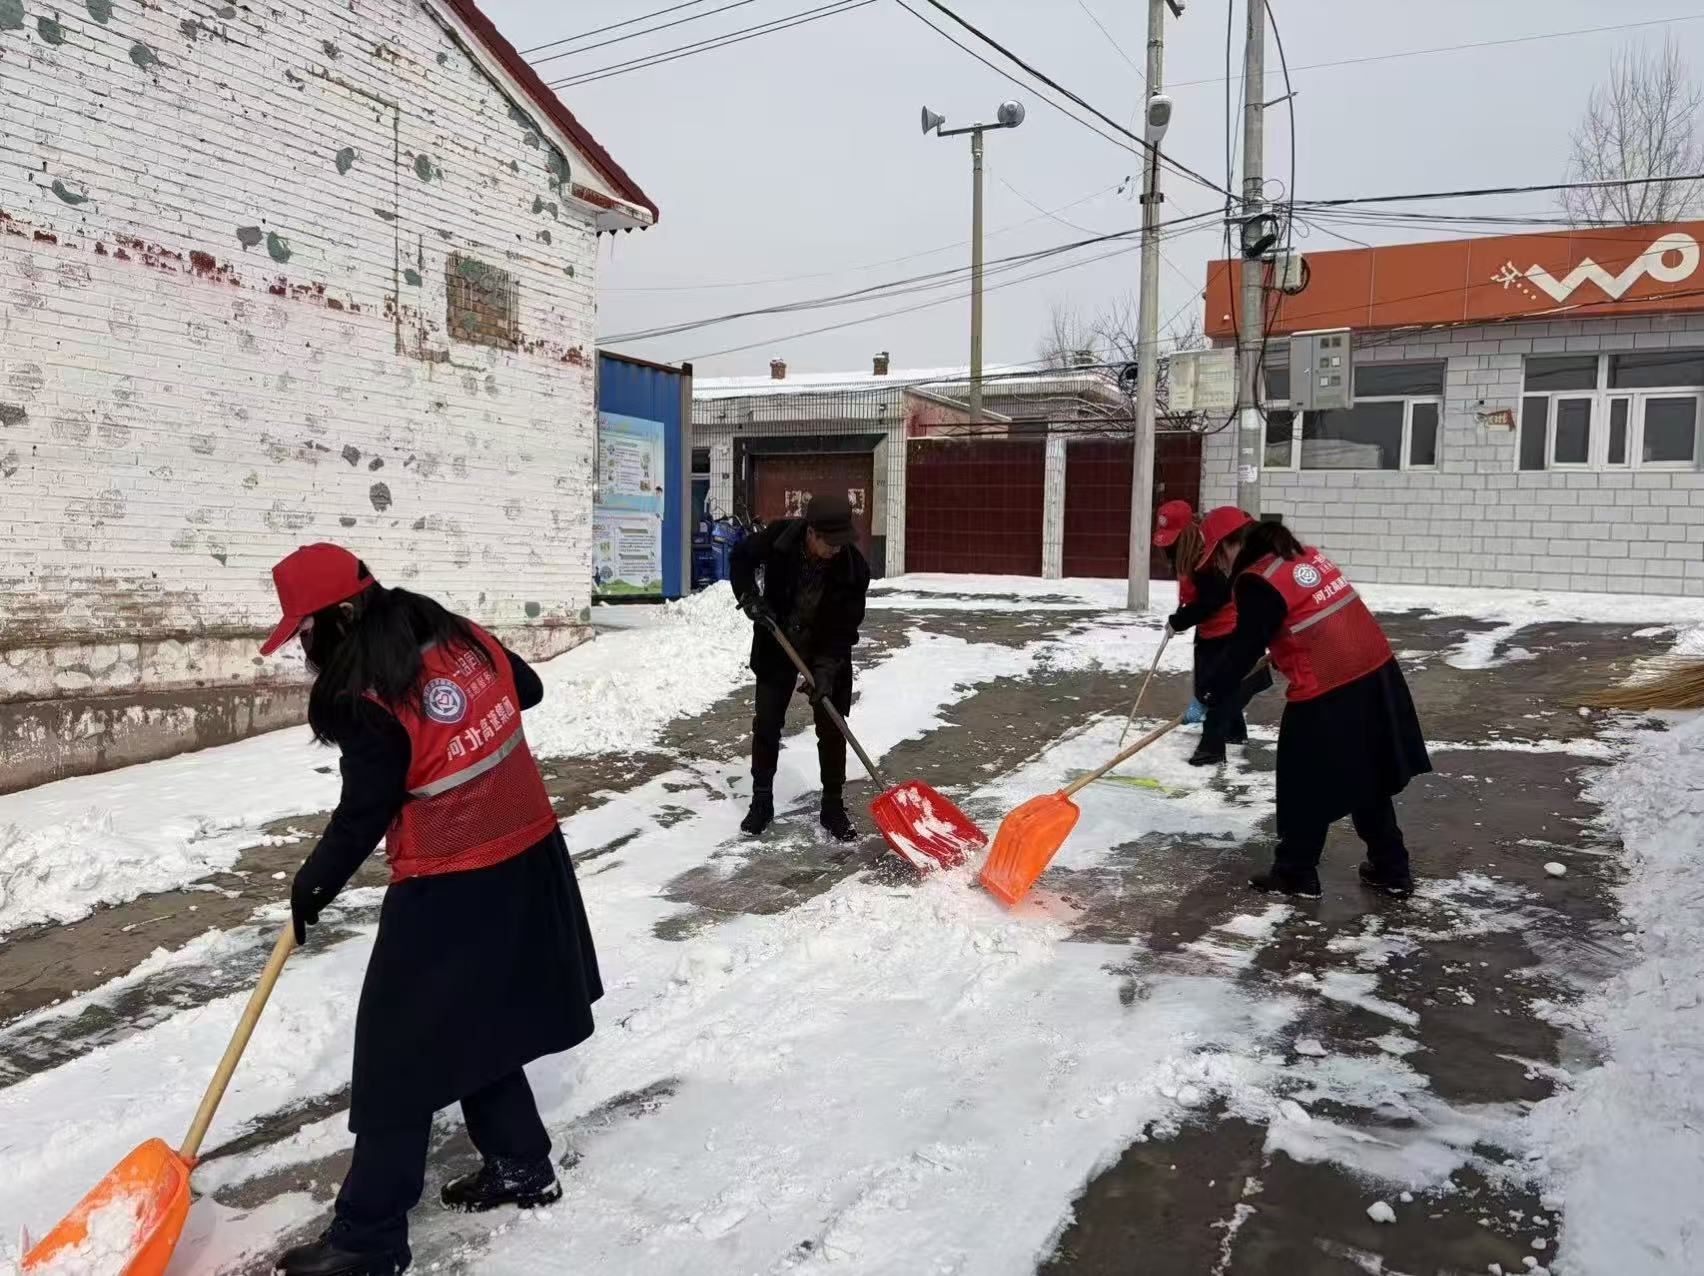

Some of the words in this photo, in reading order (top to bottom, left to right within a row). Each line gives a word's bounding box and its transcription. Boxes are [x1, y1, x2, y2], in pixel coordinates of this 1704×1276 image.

[447, 696, 515, 760] 河北高速集团
